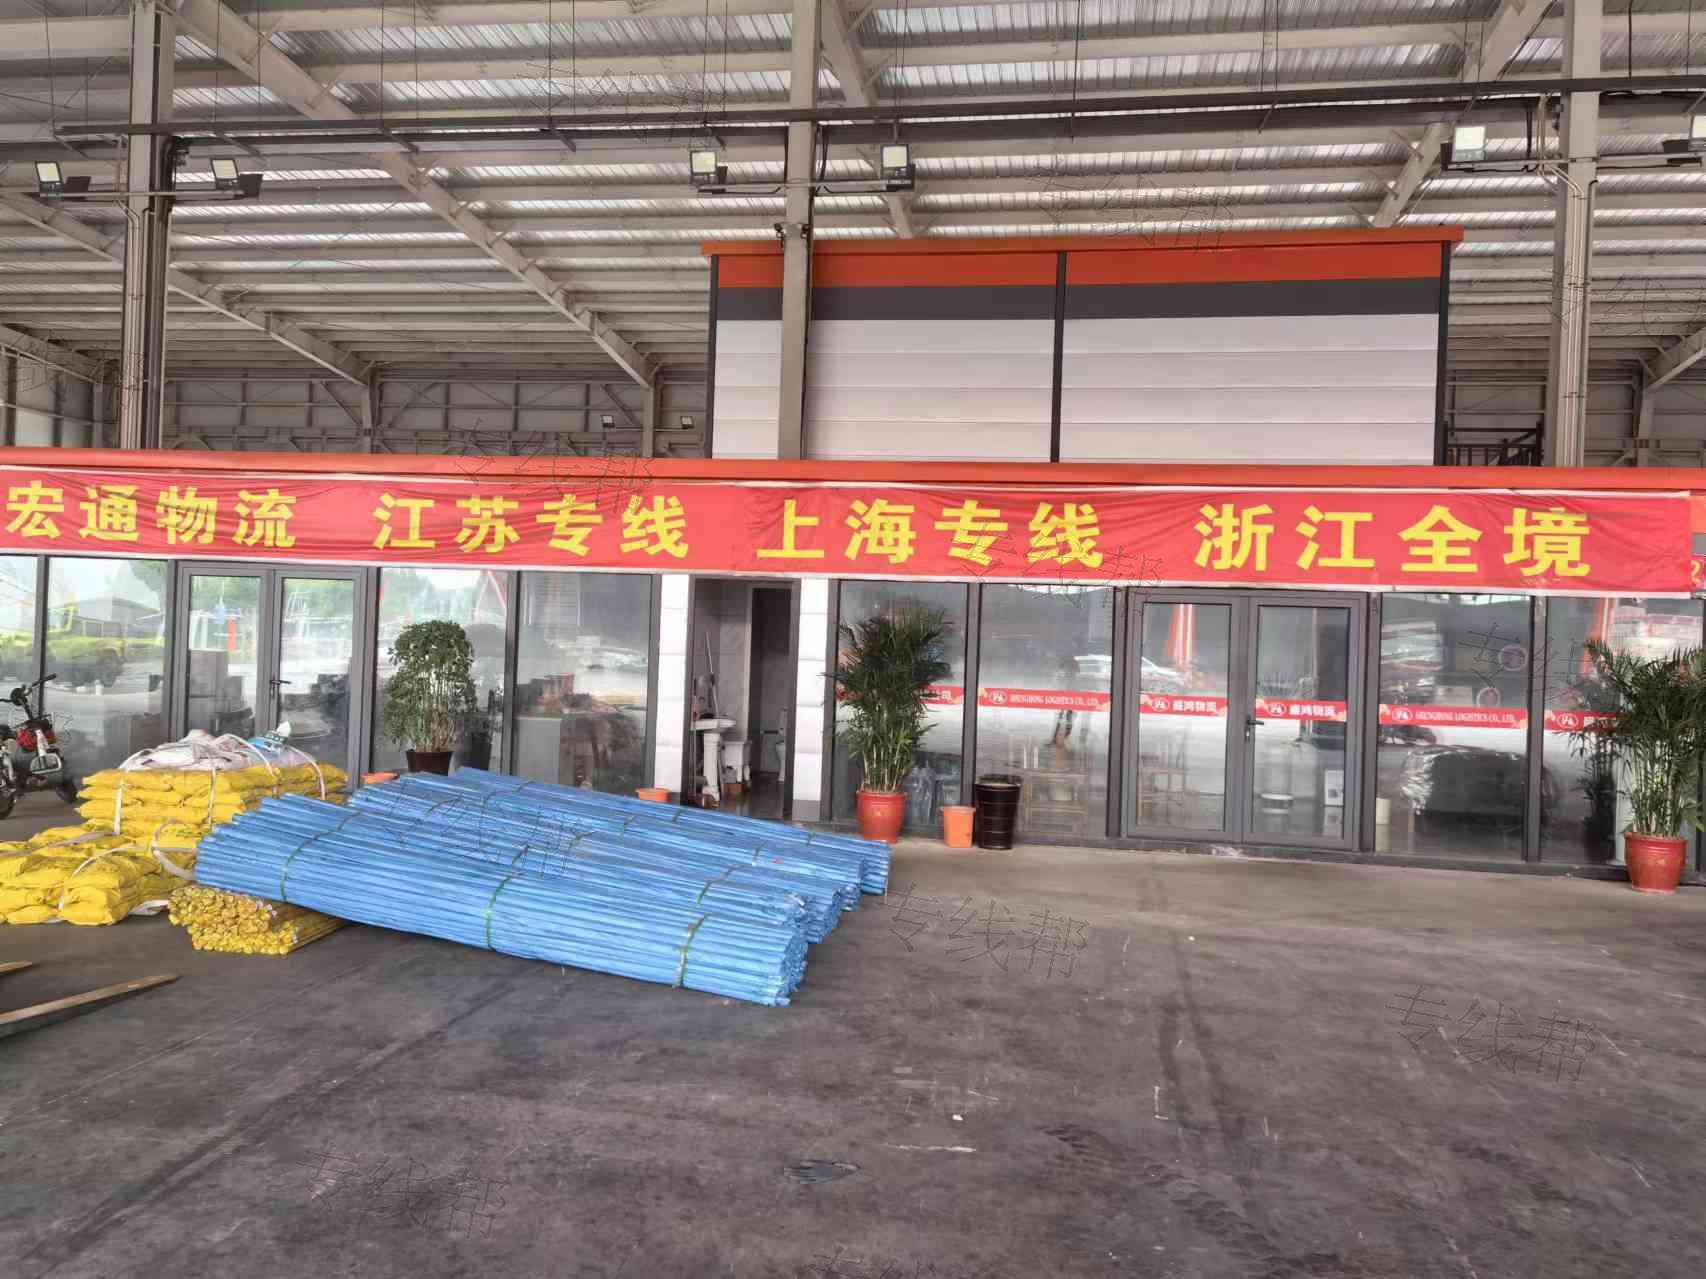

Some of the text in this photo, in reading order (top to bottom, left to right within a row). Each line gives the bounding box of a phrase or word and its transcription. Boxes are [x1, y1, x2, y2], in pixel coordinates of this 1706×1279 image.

[5, 484, 1591, 577] 宏通物流 江苏专线 上海专线 浙江全境
